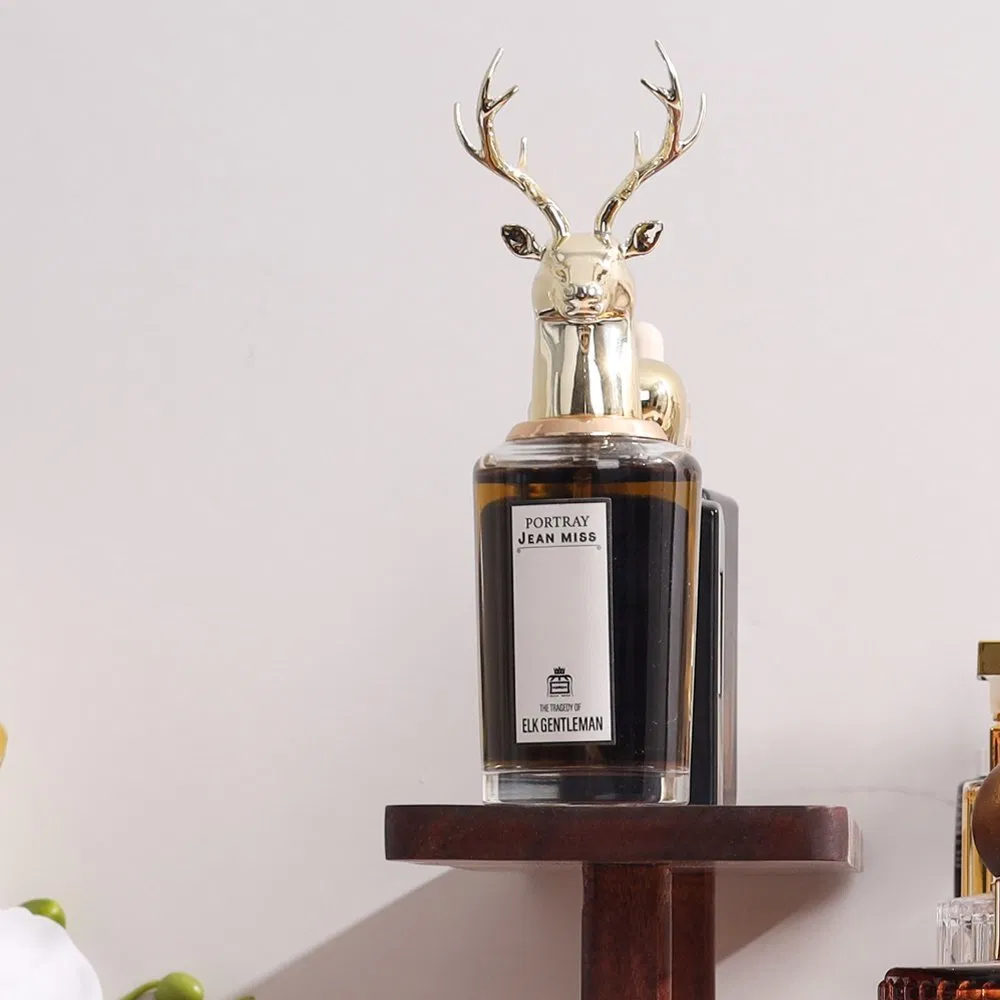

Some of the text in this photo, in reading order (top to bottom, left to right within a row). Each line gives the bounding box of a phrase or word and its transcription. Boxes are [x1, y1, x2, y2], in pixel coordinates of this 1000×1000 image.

[525, 515, 590, 529] PORTRAY
[518, 531, 597, 544] JEAN MISS
[539, 702, 582, 712] THE TRAGEDY OF
[522, 716, 603, 733] ELK GENTLEMAN
